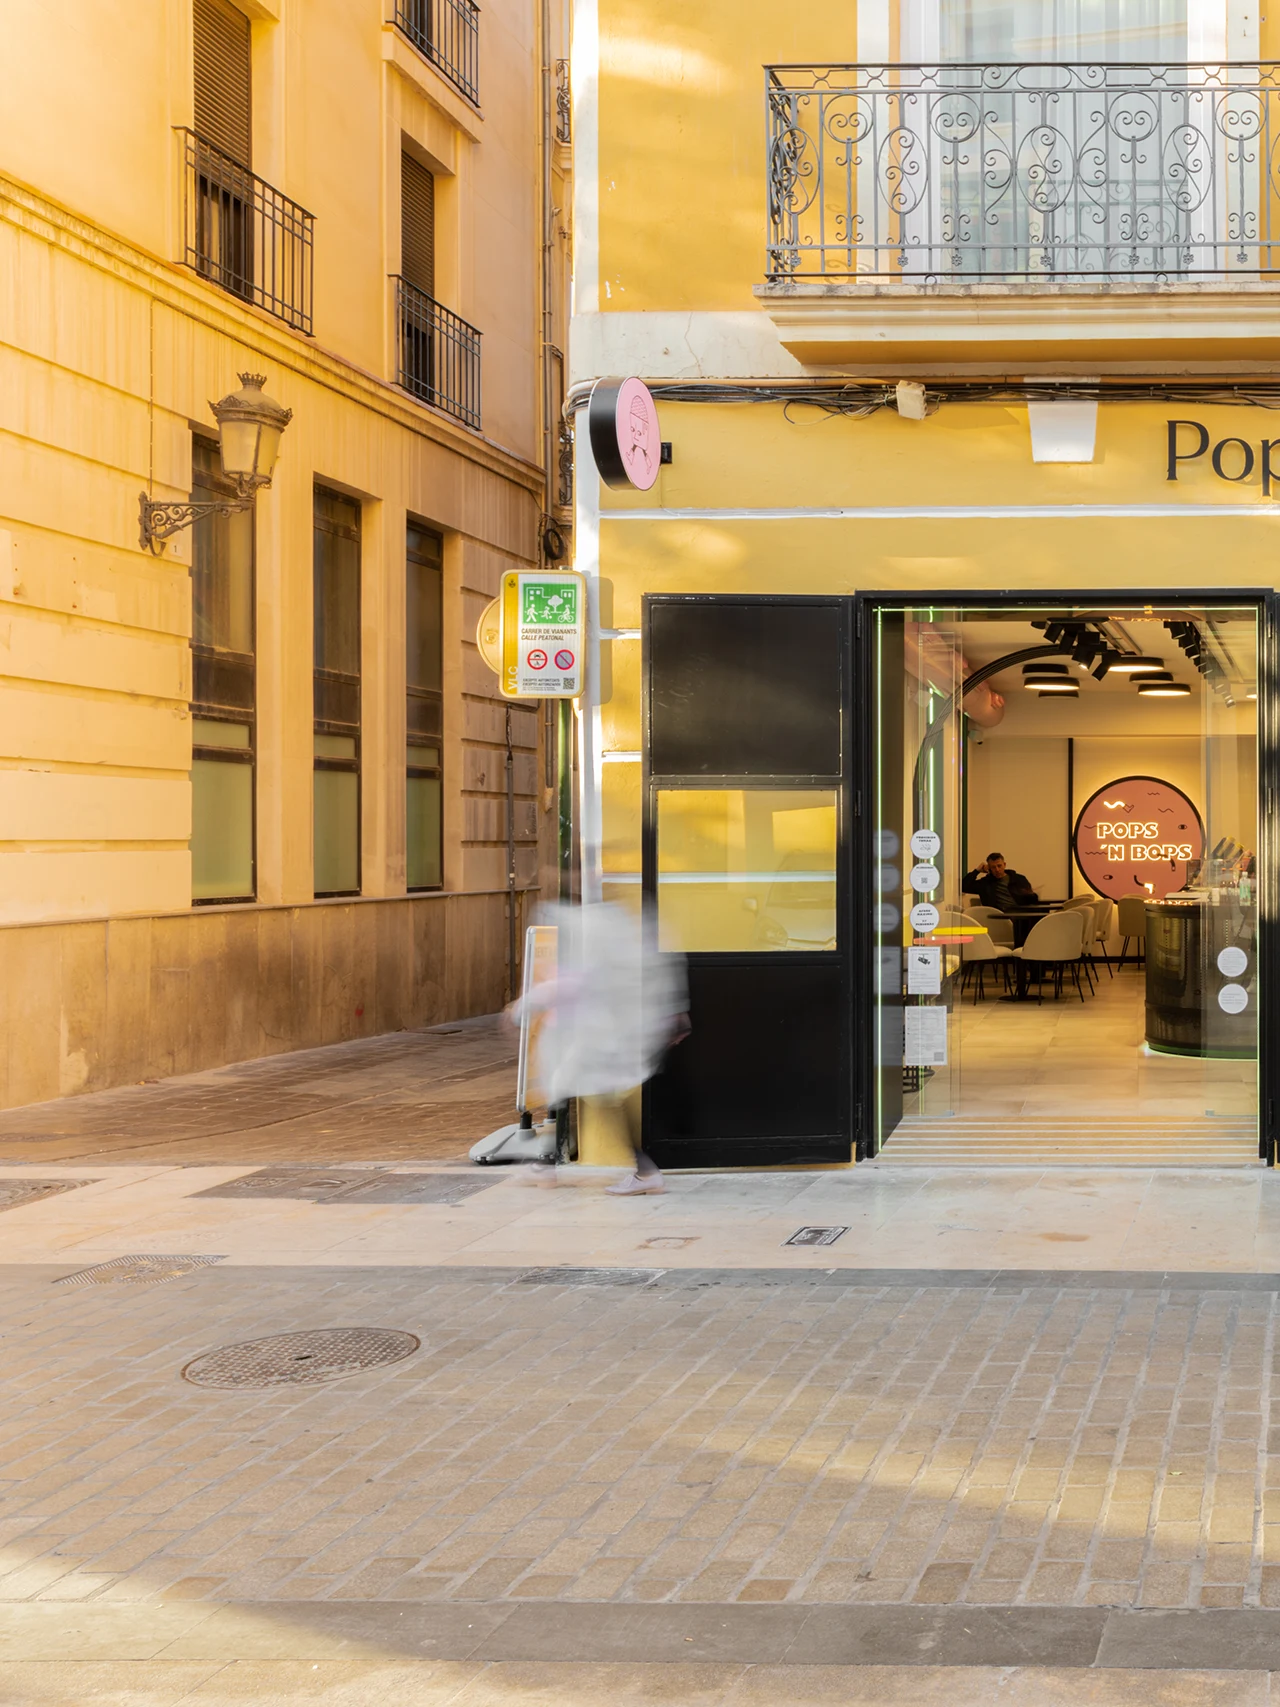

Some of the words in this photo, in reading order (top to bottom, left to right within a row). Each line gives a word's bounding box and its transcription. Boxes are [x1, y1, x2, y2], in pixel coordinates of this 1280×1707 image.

[508, 666, 518, 690] VLC
[1096, 822, 1159, 839] POPS
[1130, 844, 1193, 861] BOPS
